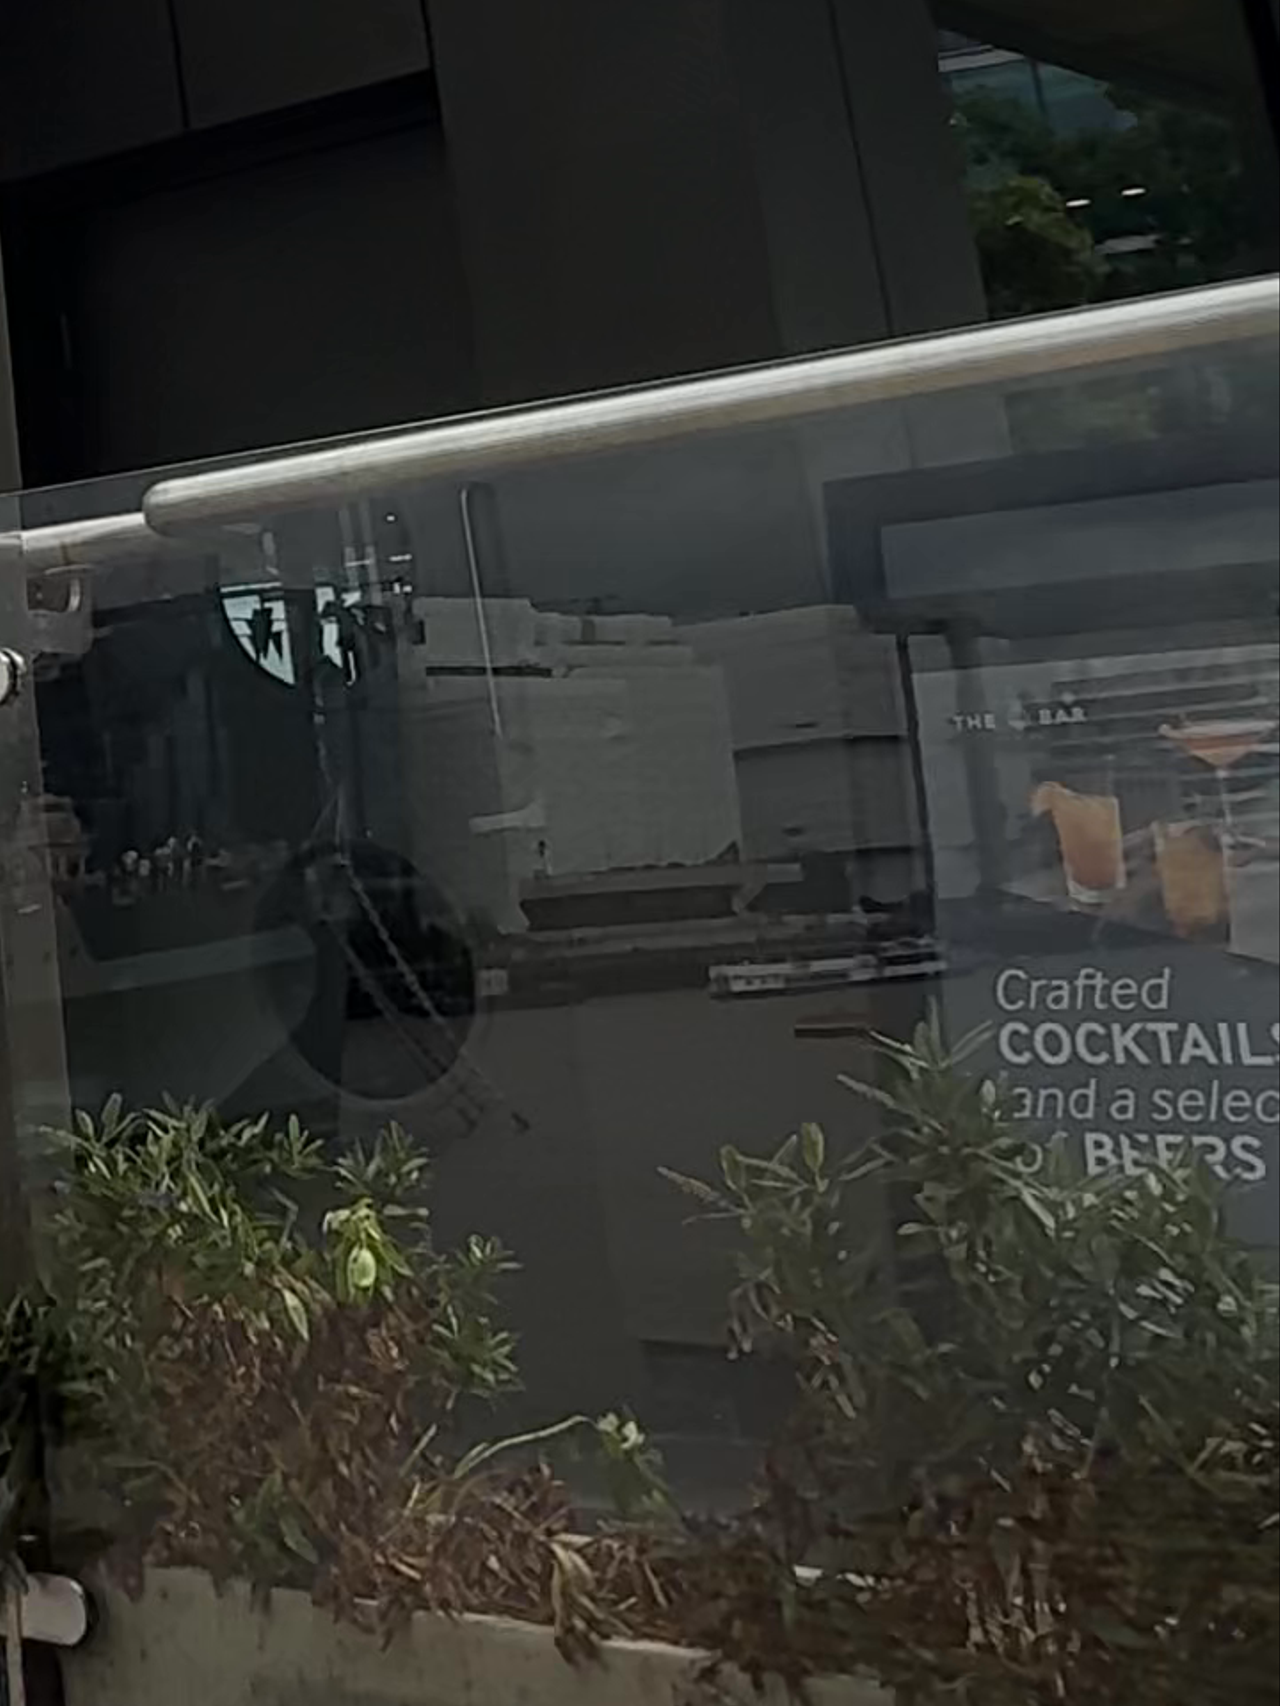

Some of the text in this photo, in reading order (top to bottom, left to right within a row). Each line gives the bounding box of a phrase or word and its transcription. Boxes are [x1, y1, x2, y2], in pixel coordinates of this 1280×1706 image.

[995, 968, 1172, 1011] Crafted
[998, 1020, 1280, 1067] COCKTAIL
[1109, 1088, 1136, 1121] a
